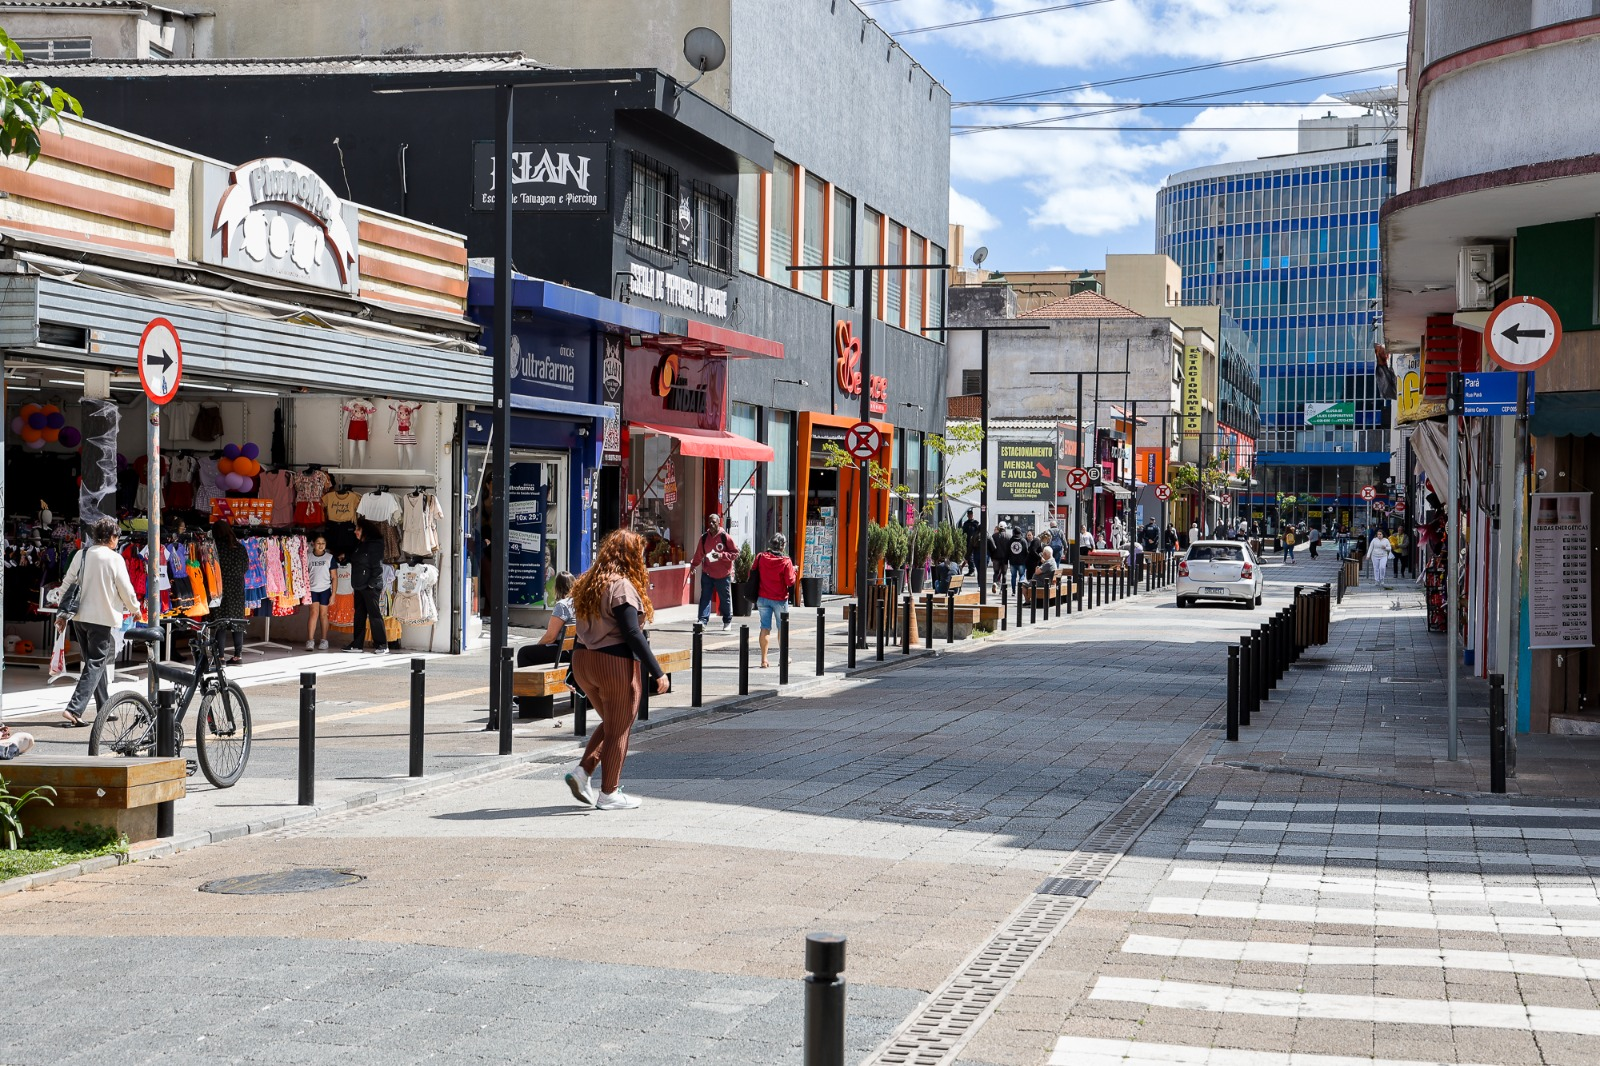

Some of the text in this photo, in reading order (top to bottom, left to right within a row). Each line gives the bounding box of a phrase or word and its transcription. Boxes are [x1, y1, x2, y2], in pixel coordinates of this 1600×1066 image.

[520, 193, 556, 206] Tatuagem
[566, 193, 598, 206] Piercing
[521, 353, 575, 384] ultrafarma
[1186, 348, 1199, 428] ESTACIONAMENTO
[1465, 378, 1480, 388] Pará
[1001, 446, 1053, 457] ESTACIONAMENTO
[1004, 461, 1035, 469] MENSAL
[1008, 471, 1037, 479] AVULSO
